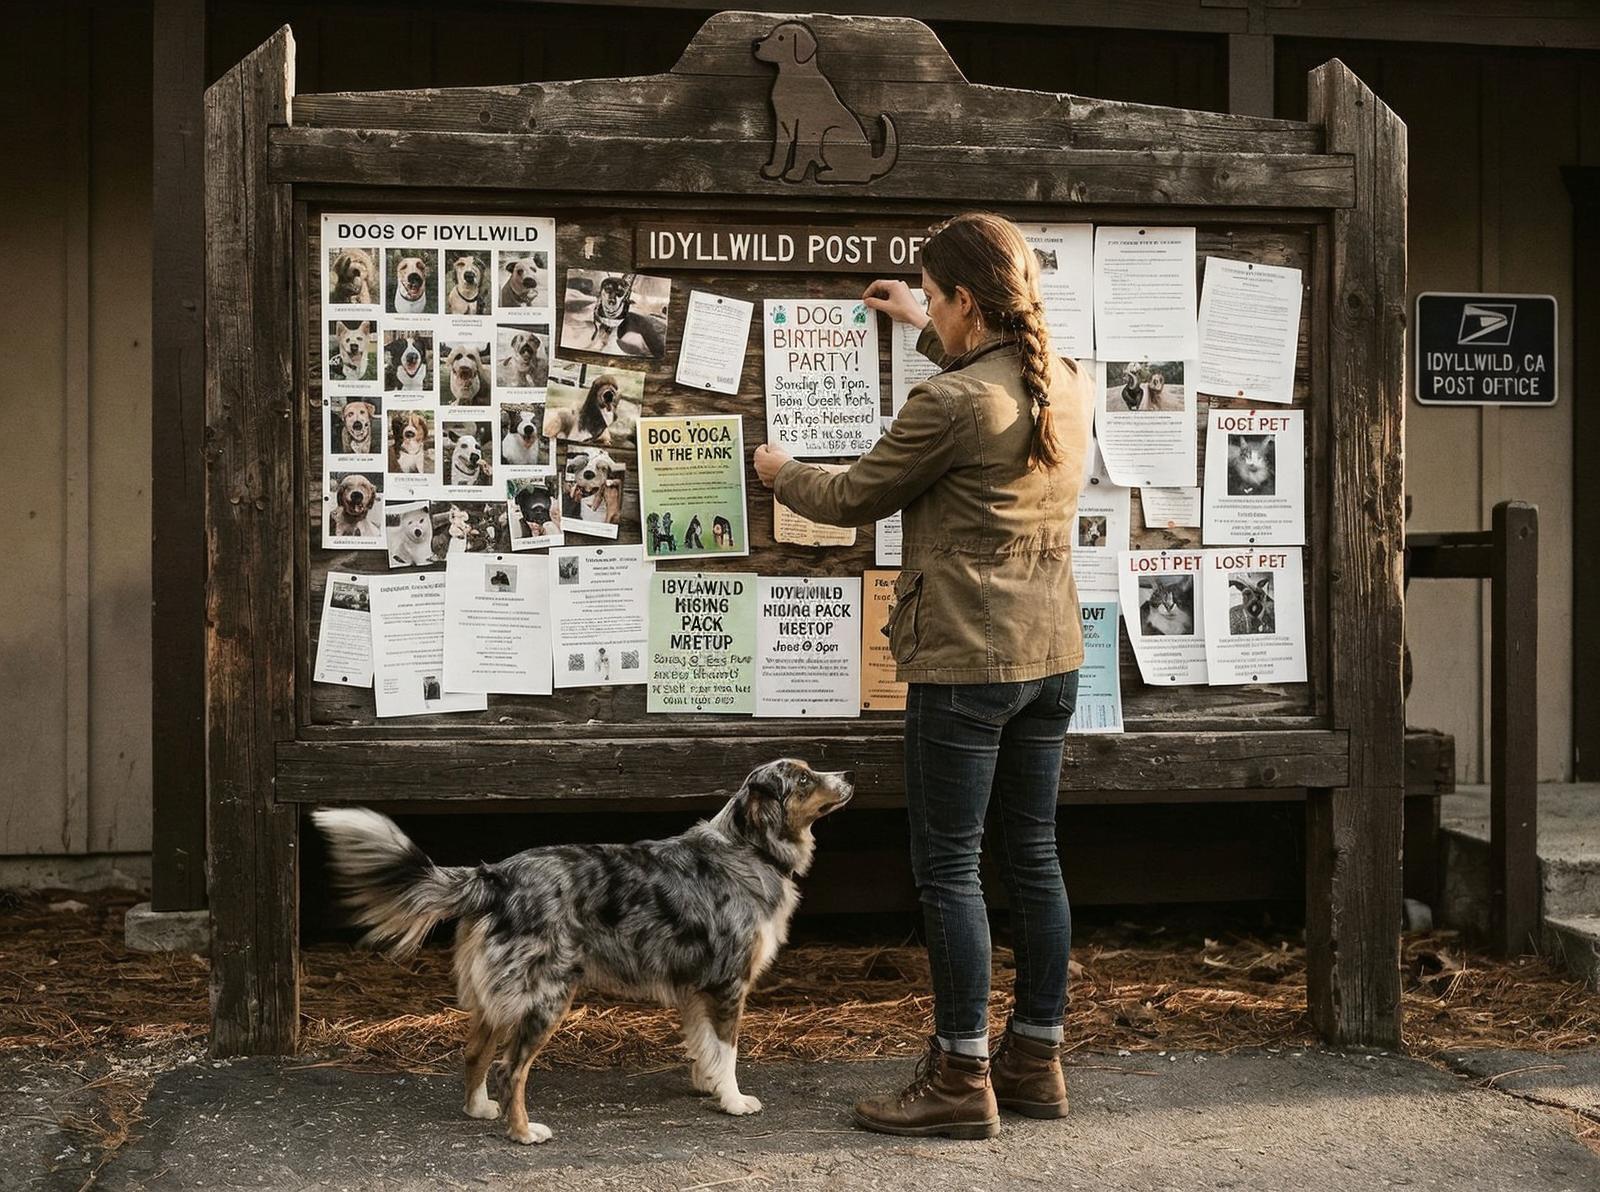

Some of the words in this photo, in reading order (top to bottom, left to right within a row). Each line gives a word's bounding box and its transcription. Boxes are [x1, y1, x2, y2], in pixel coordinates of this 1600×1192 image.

[401, 225, 428, 241] OF
[433, 225, 539, 242] IDYLLWILD
[649, 231, 795, 262] IDYLLWILD
[808, 235, 877, 264] POST
[889, 235, 930, 265] OF
[796, 305, 843, 325] DOG
[773, 329, 868, 349] BIRTHDAY
[788, 350, 859, 373] PARTY!
[1524, 353, 1546, 373] CA
[1433, 376, 1475, 395] POST
[1259, 417, 1291, 431] PET
[667, 447, 693, 461] THE
[1130, 557, 1171, 572] LOST
[1173, 556, 1202, 571] PET
[1215, 555, 1254, 570] LOST
[815, 603, 852, 618] PACK
[682, 615, 724, 633] PACK
